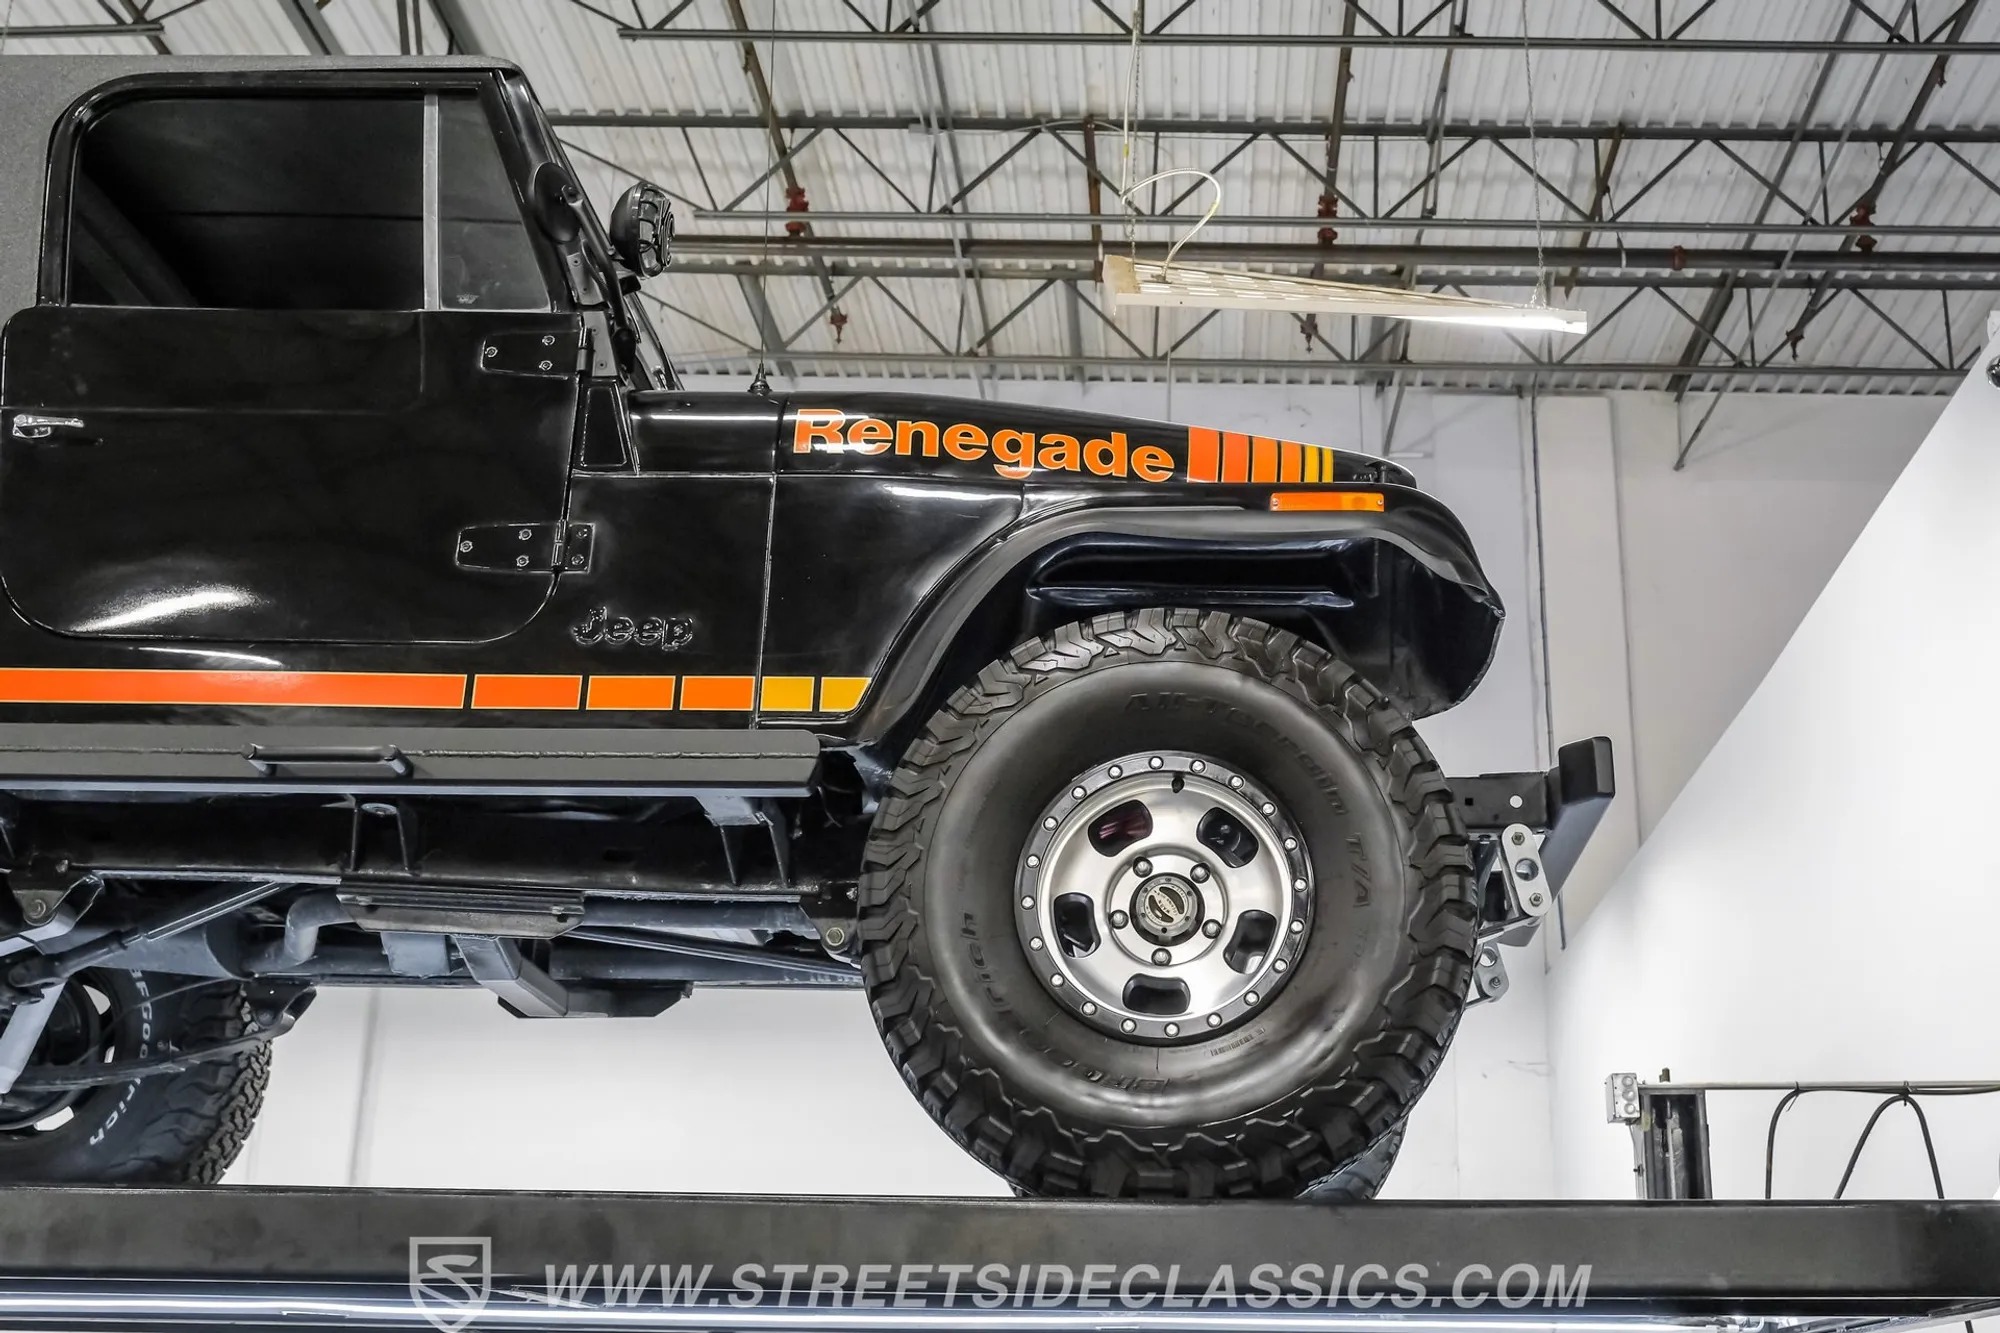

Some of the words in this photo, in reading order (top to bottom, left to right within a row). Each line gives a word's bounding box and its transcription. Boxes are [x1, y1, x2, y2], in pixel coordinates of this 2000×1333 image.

[793, 408, 1175, 483] Renegade
[570, 606, 693, 651] Jeep
[89, 968, 153, 1146] BFGoorich
[960, 912, 1170, 1092] BFGorich
